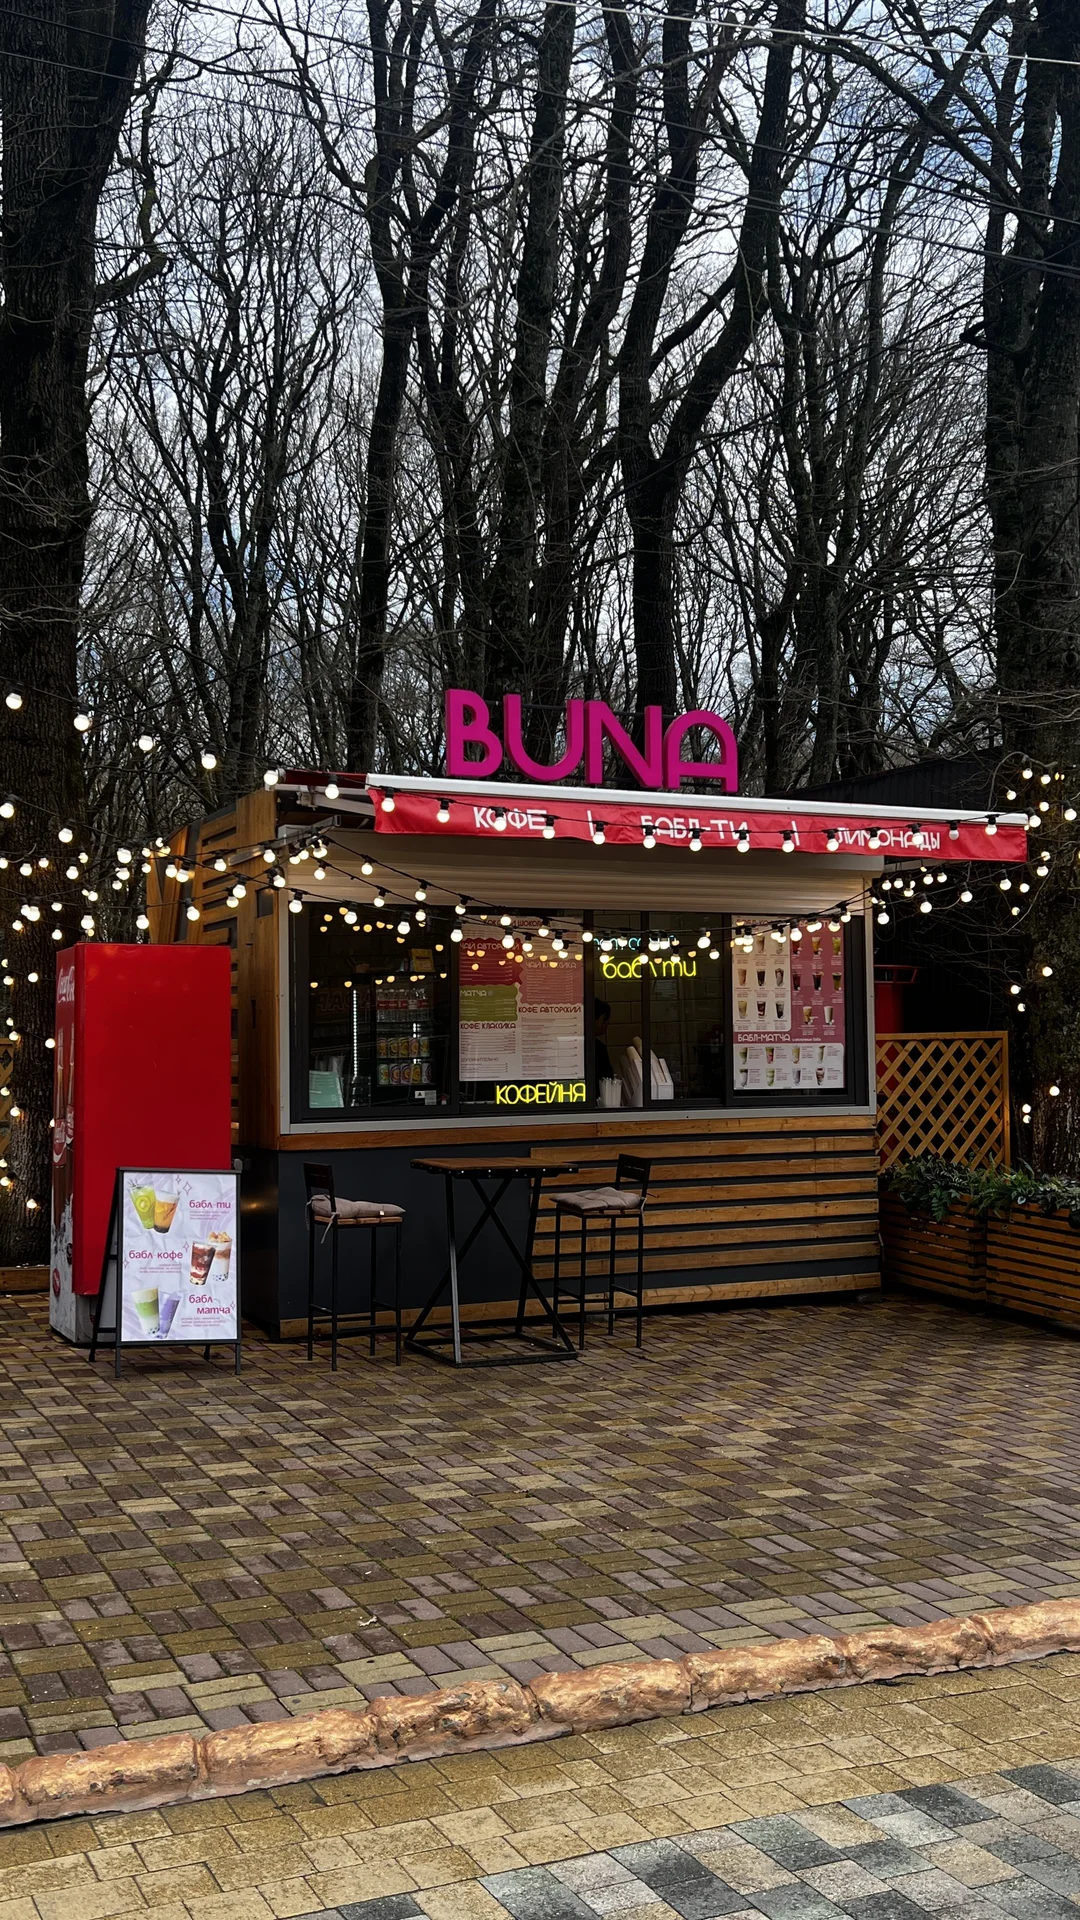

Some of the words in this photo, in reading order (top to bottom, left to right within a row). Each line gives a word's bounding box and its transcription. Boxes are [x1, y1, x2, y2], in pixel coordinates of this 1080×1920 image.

[445, 689, 738, 793] BUNA
[473, 807, 547, 830] КОФЕ
[641, 815, 750, 841] БАБЛ-ТИ
[837, 827, 941, 851] ЛИМОНАДЫ
[460, 989, 487, 997] МАТЧА
[482, 1022, 517, 1030] КЛАССИКА
[738, 1033, 791, 1042] БАБЛ-МАТЧА
[496, 1081, 586, 1104] КОФЕЙНЯ
[197, 1306, 231, 1314] матча
